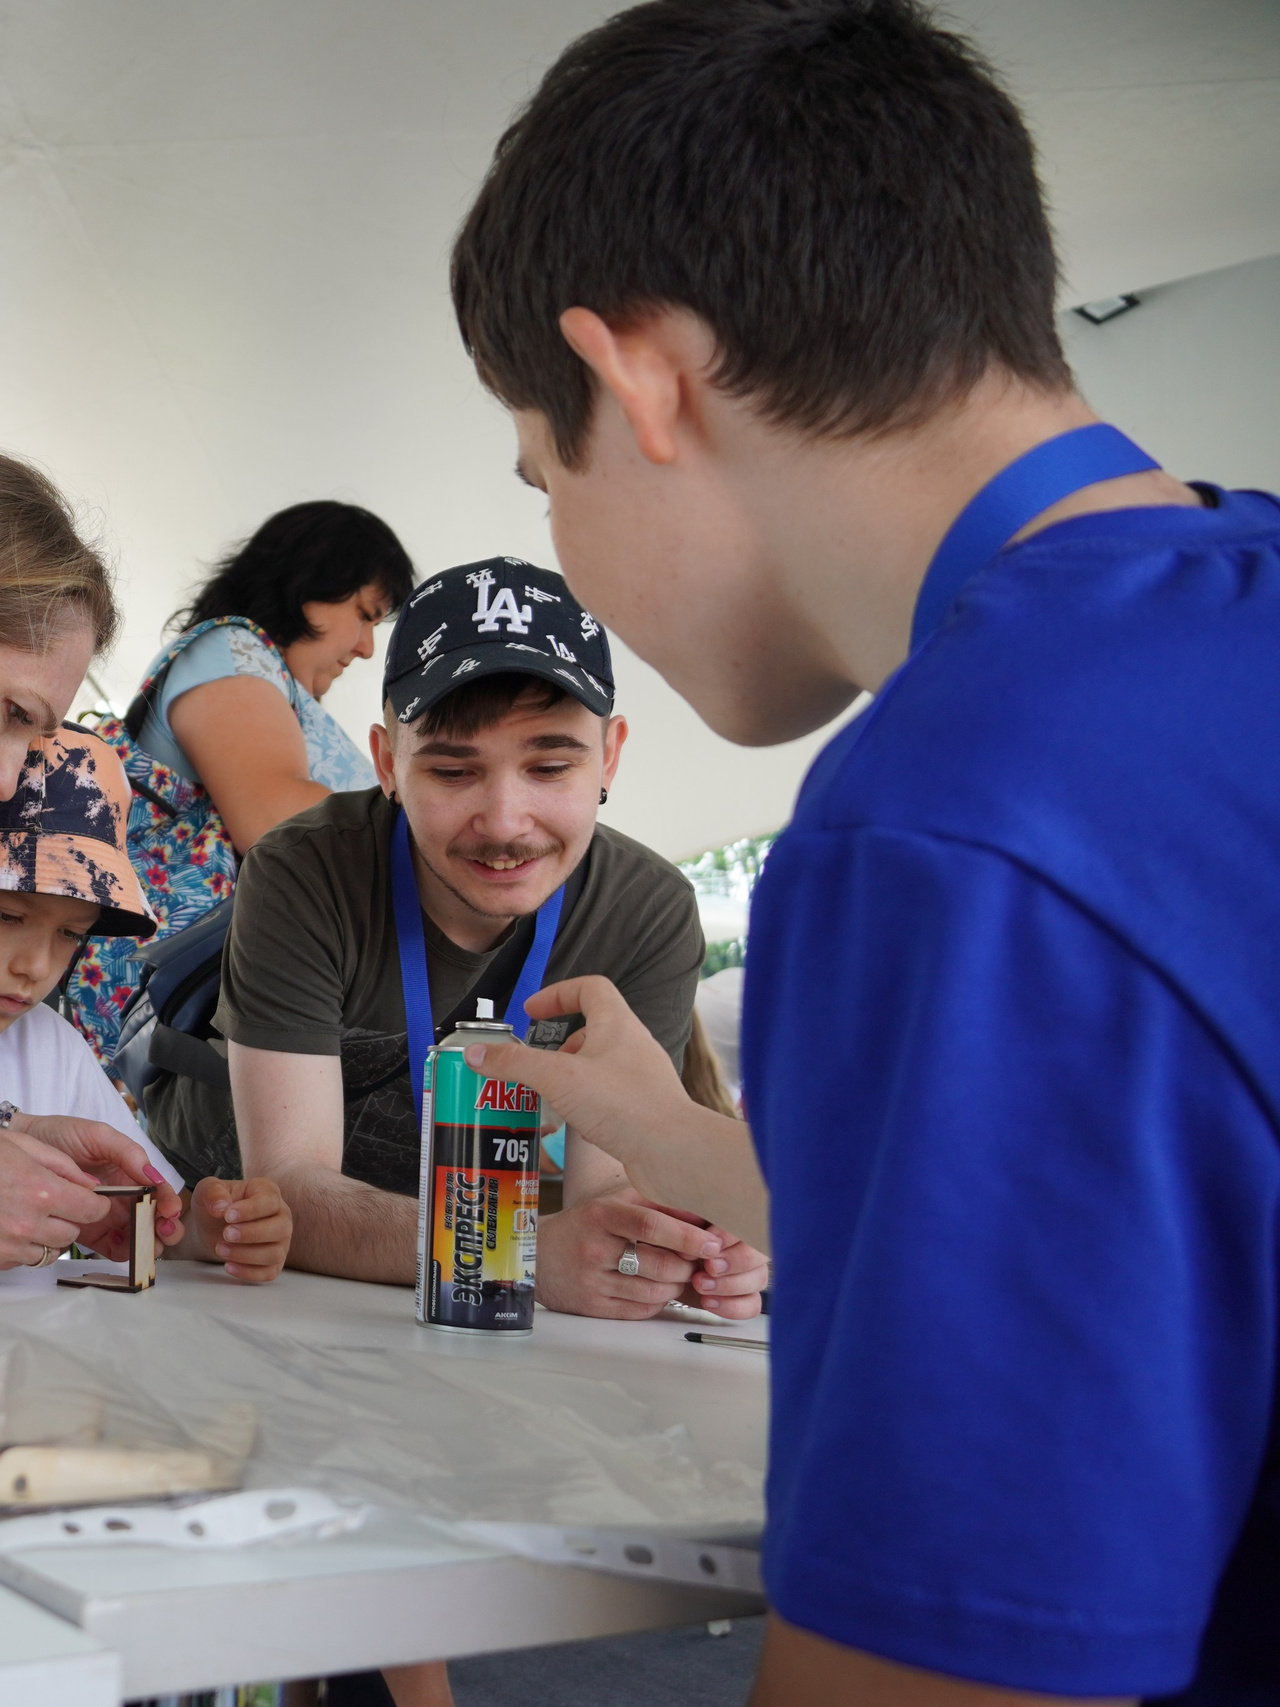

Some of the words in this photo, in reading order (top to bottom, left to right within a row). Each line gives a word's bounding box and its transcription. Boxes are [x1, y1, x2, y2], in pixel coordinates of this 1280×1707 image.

[472, 578, 532, 634] LA
[474, 1078, 538, 1112] Akfix
[492, 1138, 529, 1163] 705
[446, 1172, 455, 1196] ДЛЯ
[445, 1194, 453, 1230] НАБОР
[486, 1177, 499, 1250] СКЛЕИВАНИЯ
[451, 1172, 486, 1306] ЭКСПРЕСС
